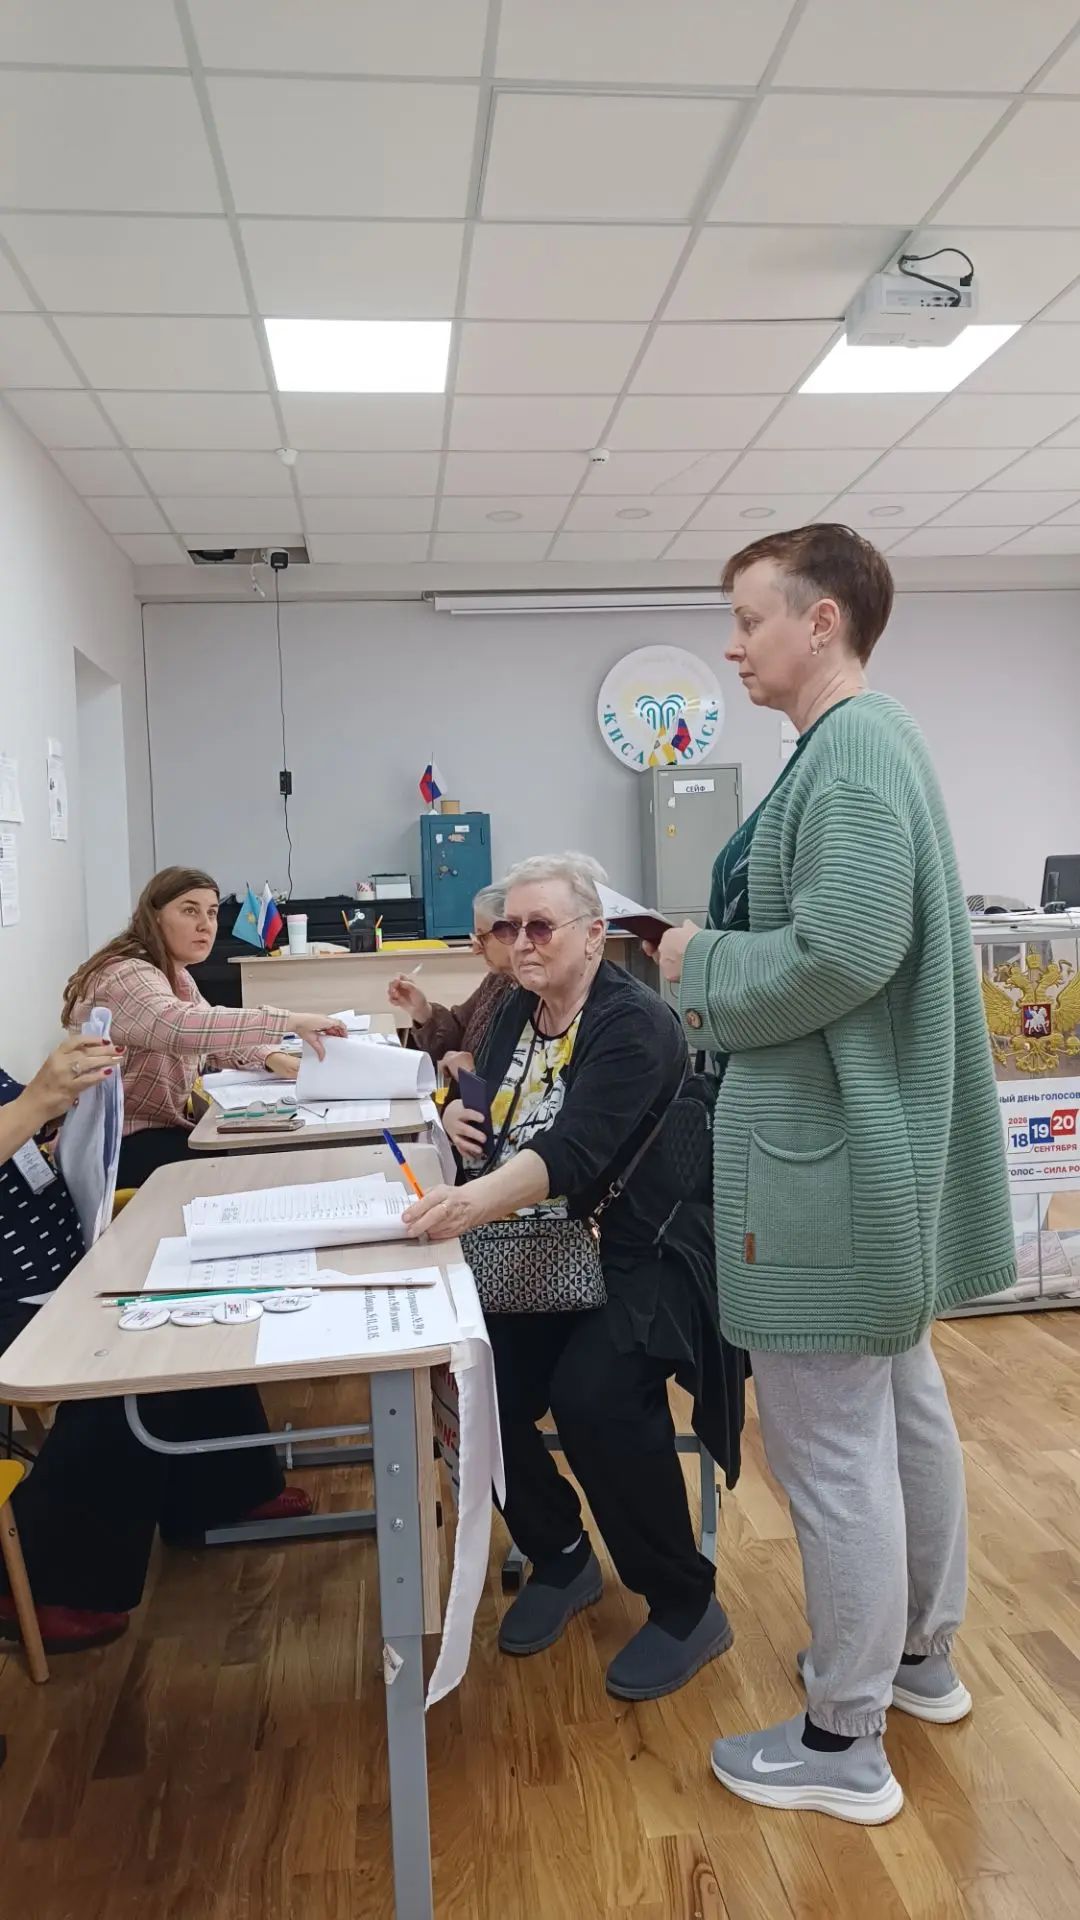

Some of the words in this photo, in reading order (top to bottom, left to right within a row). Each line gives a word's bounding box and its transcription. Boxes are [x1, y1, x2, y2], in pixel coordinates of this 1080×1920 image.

[603, 709, 719, 766] КИСЛОДСК
[685, 784, 706, 793] СЕЙФ
[1017, 1094, 1040, 1103] ДЕНЬ
[1011, 1133, 1028, 1148] 18
[1031, 1123, 1049, 1139] 19
[1052, 1114, 1074, 1131] 20
[1034, 1144, 1077, 1152] СЕНТЯБРЯ
[1008, 1168, 1034, 1176] ОЛОС
[1044, 1166, 1067, 1174] СИЛА
